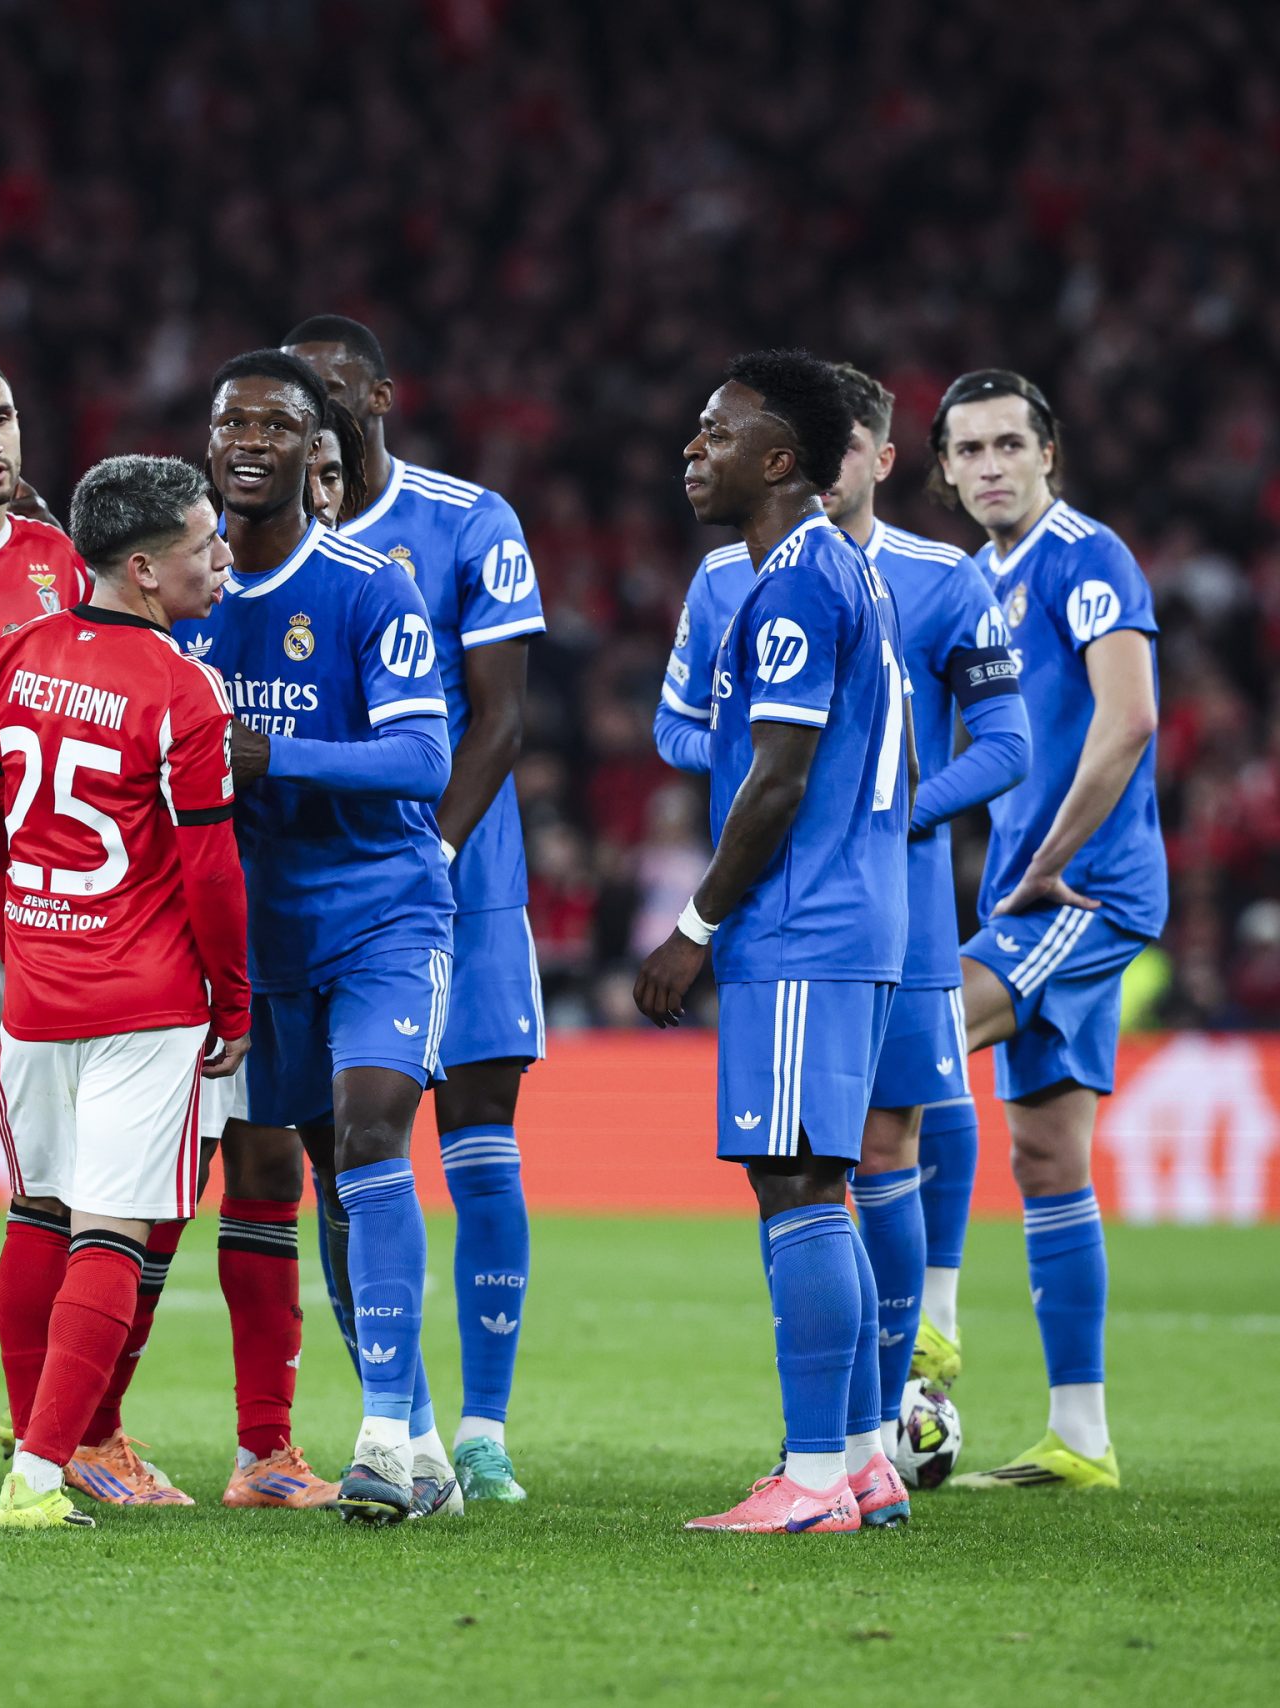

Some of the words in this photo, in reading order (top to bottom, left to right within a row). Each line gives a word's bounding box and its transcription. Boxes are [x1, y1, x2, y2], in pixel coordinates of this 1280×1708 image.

[489, 541, 528, 603] hp
[1077, 581, 1111, 638] hp
[387, 614, 430, 678] hp
[758, 617, 804, 684] hp
[986, 663, 1017, 677] RESP
[8, 669, 128, 731] PRESTIANNI
[224, 672, 319, 711] irates
[4, 900, 108, 932] FOUNDATION
[22, 894, 71, 912] BENFICA
[474, 1273, 526, 1289] RMCF
[878, 1295, 916, 1308] MCF
